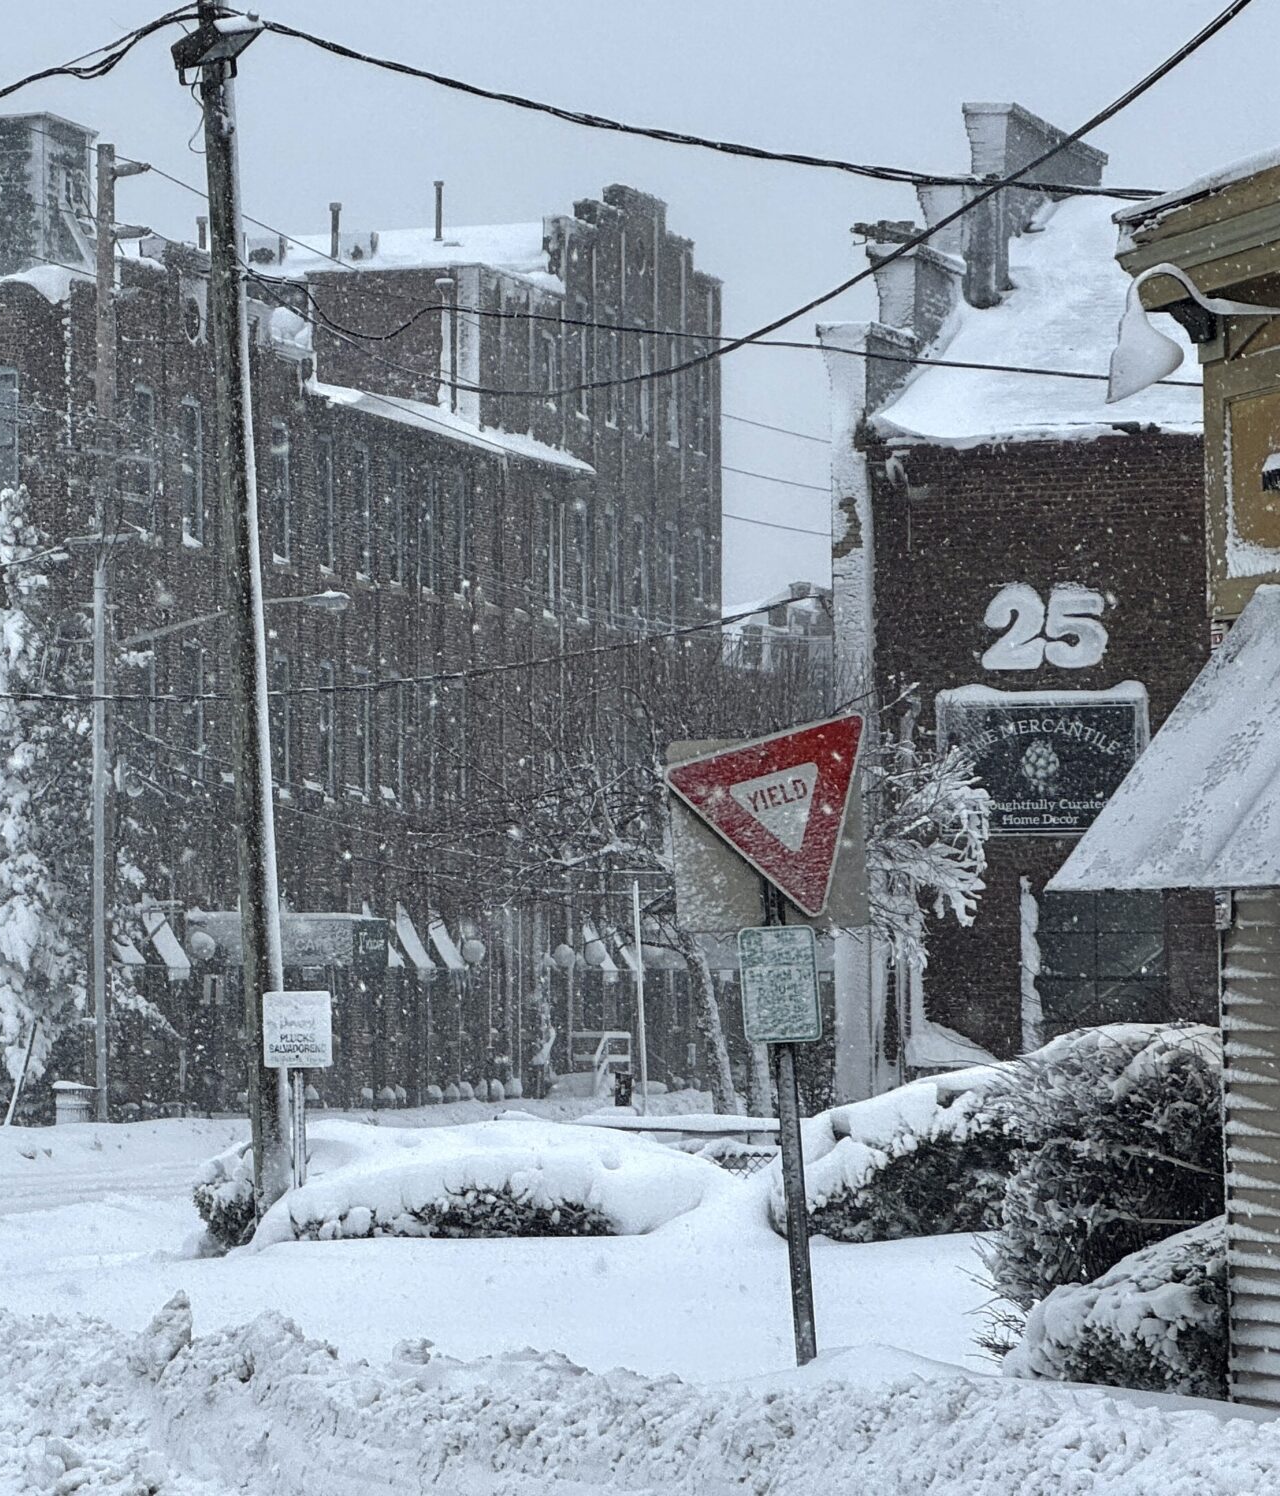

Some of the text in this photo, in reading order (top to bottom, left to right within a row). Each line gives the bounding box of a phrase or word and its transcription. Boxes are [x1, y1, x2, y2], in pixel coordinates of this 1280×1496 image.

[981, 580, 1110, 670] 25
[964, 718, 1120, 756] THE MERCANTILE
[747, 779, 808, 813] YIELD
[977, 799, 1055, 811] oughtfully
[1002, 813, 1080, 826] Home Decor
